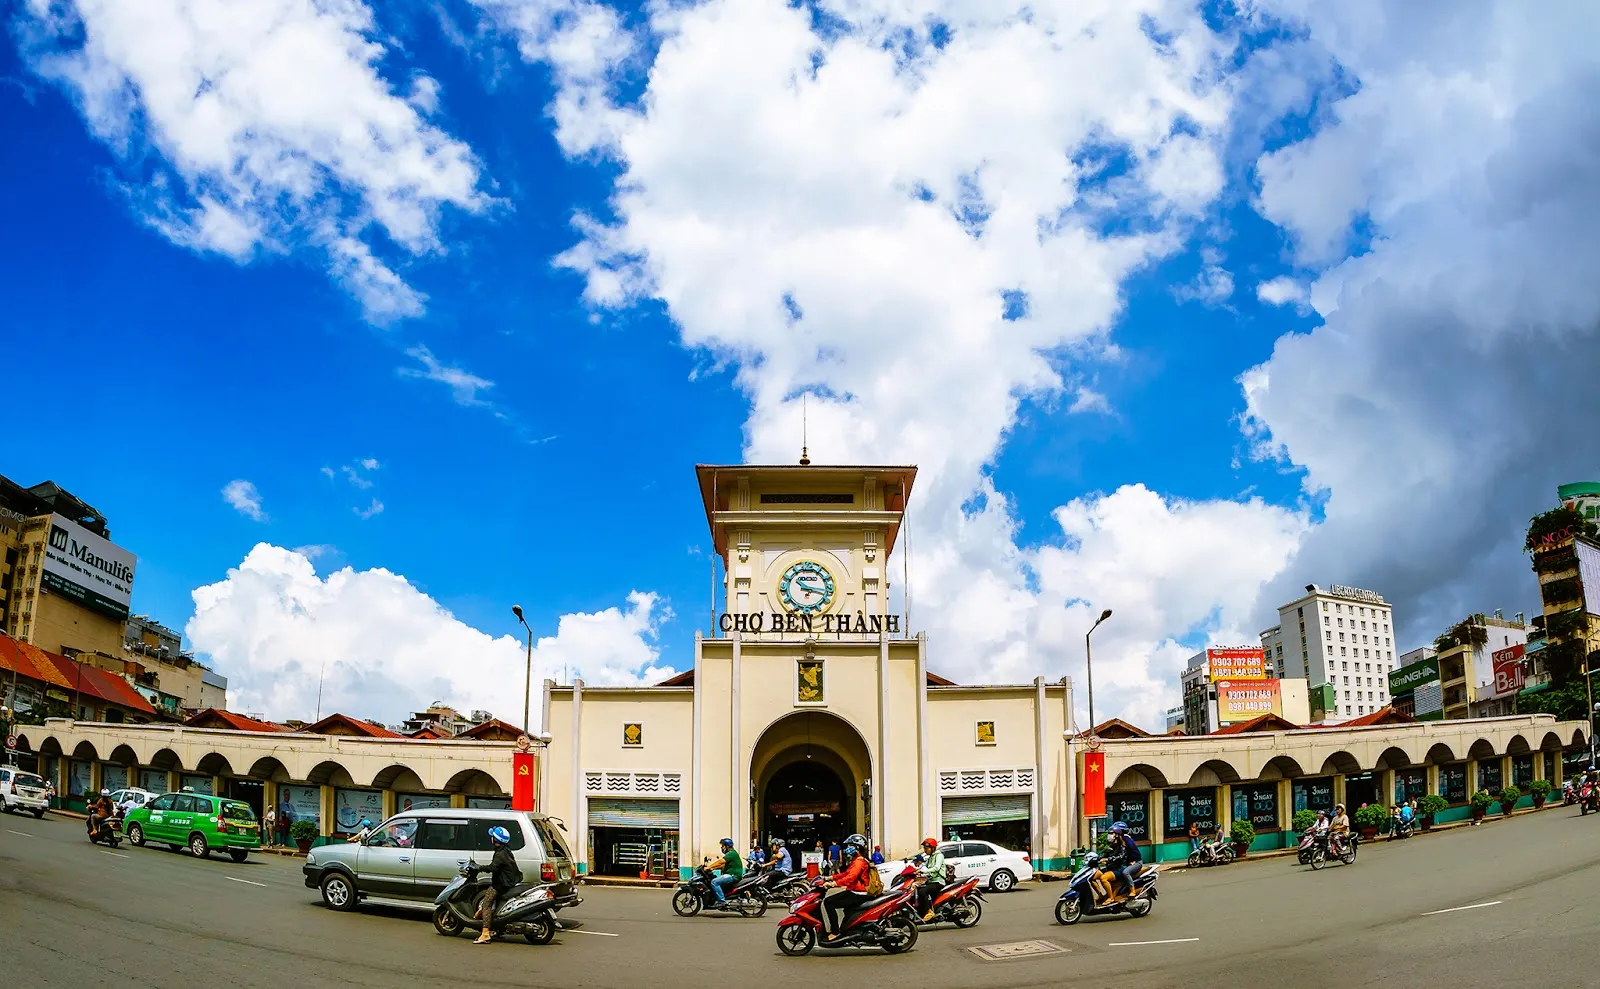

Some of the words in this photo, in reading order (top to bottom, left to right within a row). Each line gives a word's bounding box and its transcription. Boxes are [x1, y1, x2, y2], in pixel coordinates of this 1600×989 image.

[69, 538, 133, 584] Manulife
[719, 611, 764, 634] CHỢ
[771, 610, 814, 632] BẾN
[821, 610, 900, 632] THÀNH
[1212, 658, 1232, 666] 0903
[1233, 658, 1246, 666] 702
[1254, 791, 1258, 800] 3
[1312, 786, 1316, 795] 3
[1121, 801, 1126, 811] 3
[1190, 796, 1196, 806] 3
